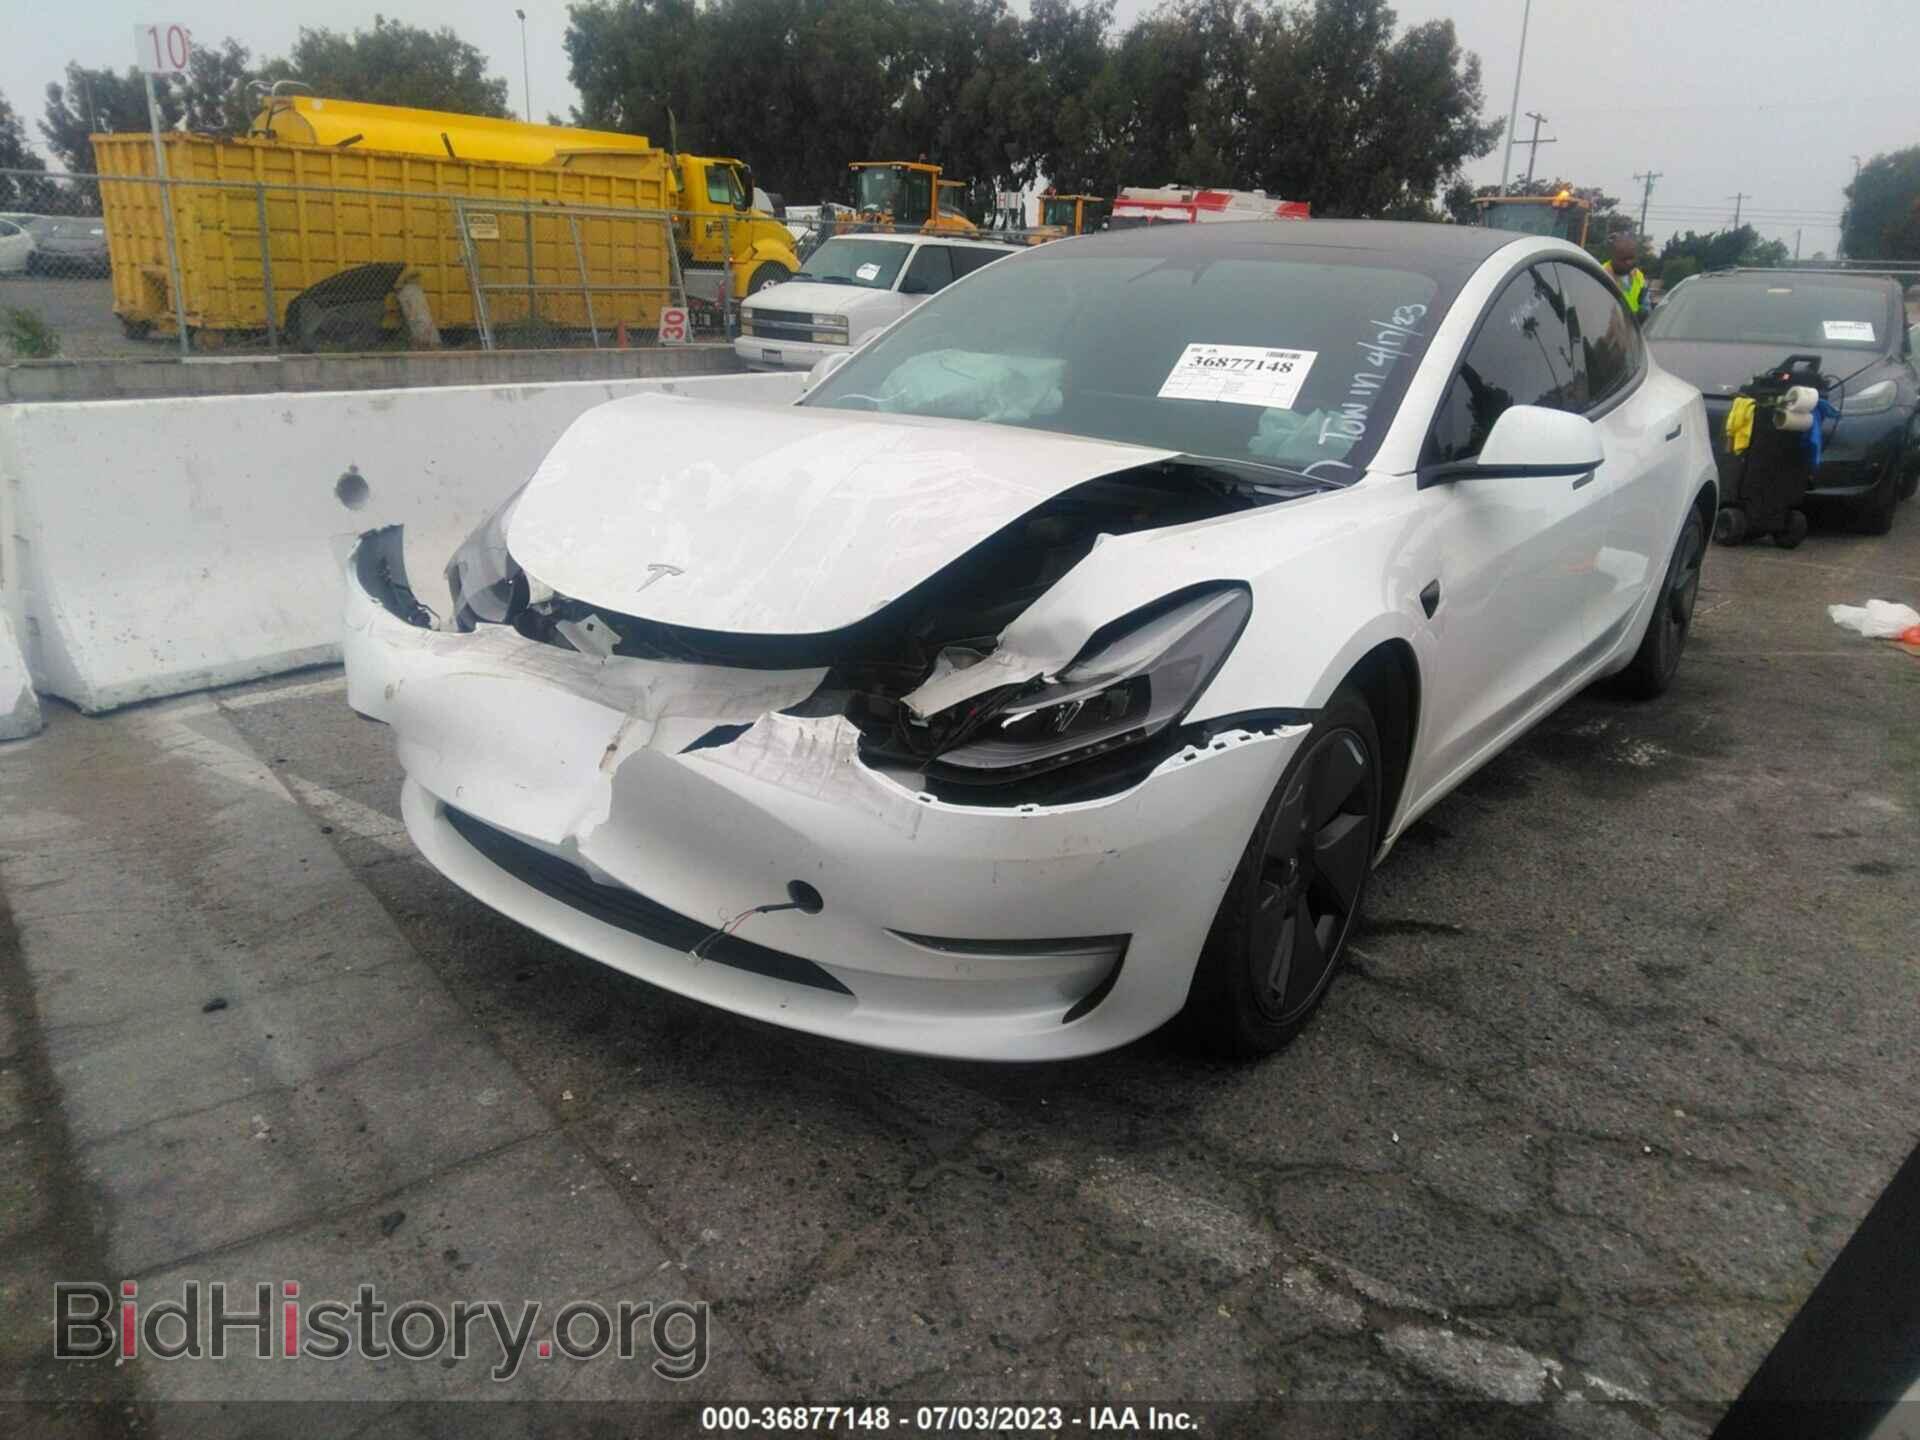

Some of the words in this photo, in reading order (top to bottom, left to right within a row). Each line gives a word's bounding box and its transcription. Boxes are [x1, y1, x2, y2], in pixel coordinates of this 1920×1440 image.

[147, 25, 187, 69] 10
[662, 310, 684, 340] 30
[1356, 303, 1427, 367] 4/17/23
[1188, 355, 1294, 373] 36877148
